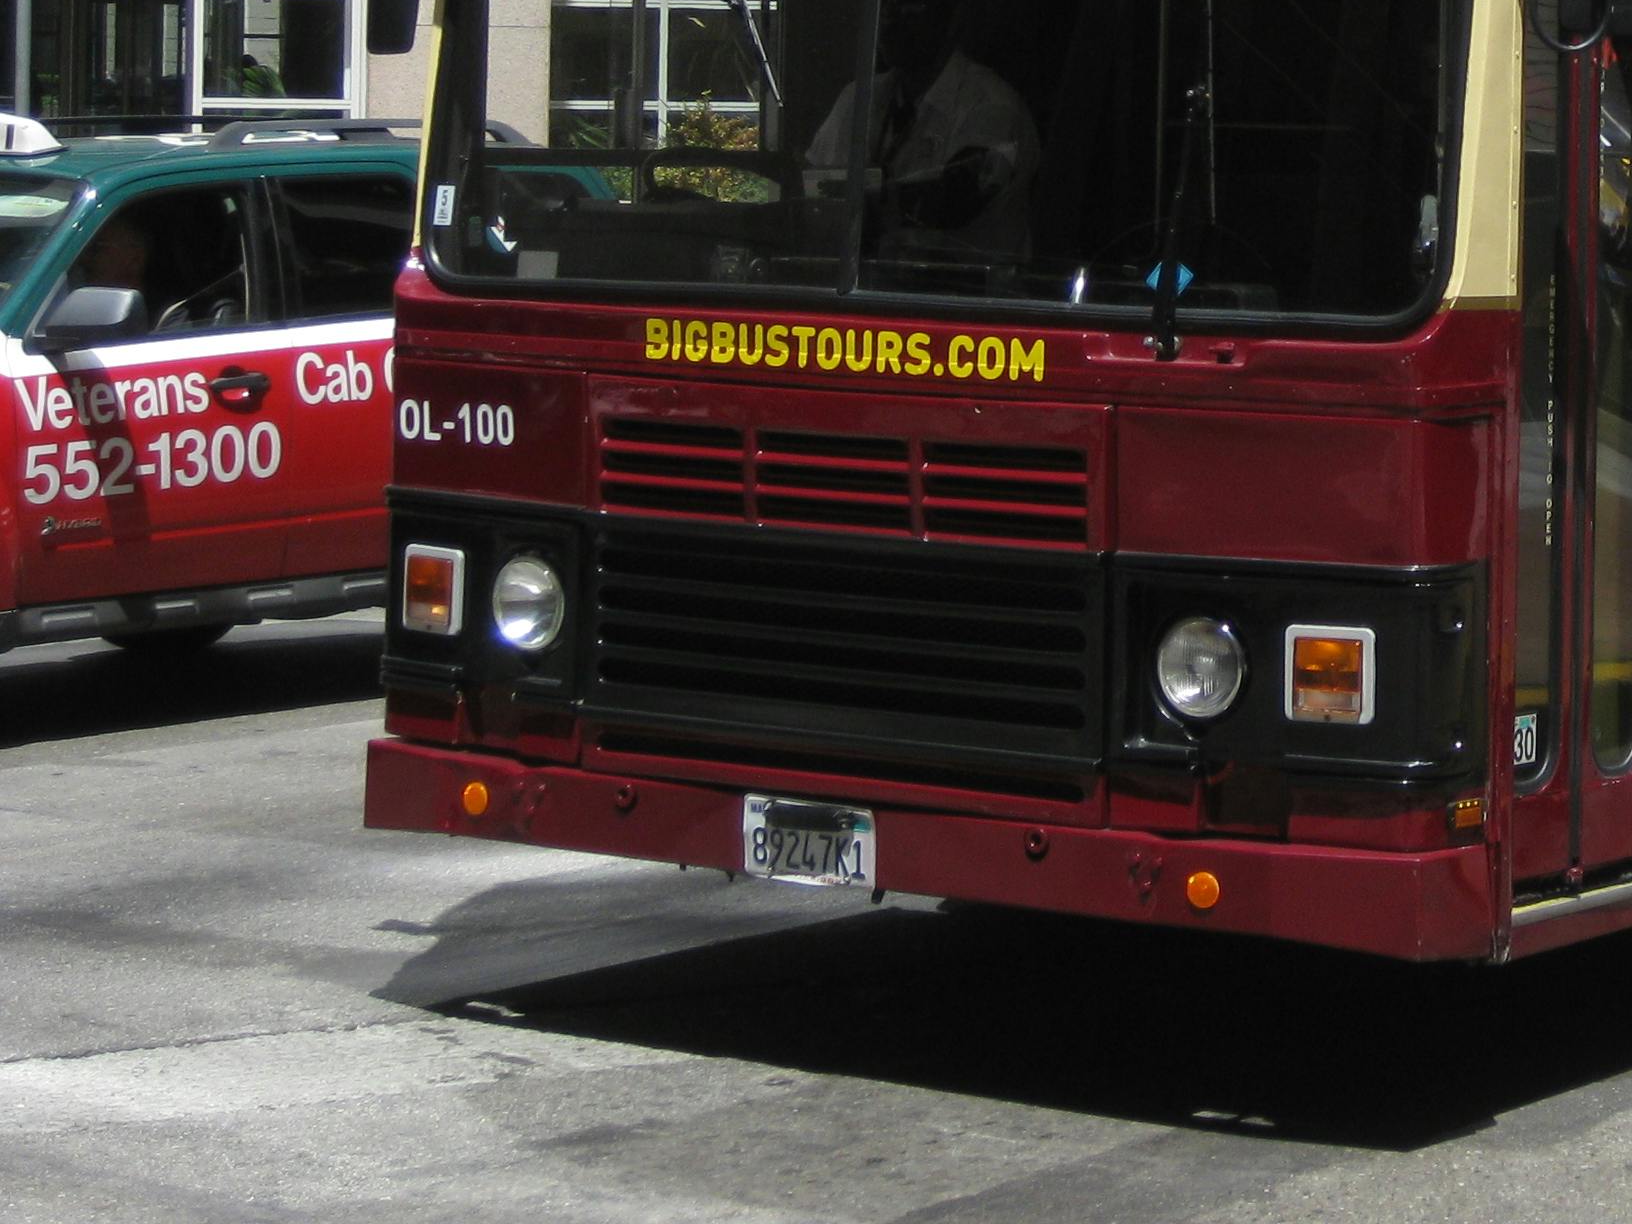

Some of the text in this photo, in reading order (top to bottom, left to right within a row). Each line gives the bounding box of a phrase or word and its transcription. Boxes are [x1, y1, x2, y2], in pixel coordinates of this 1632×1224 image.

[645, 317, 1046, 382] BIGBUSTOURS.COM
[14, 369, 210, 431] Veterans
[295, 350, 374, 405] Cab
[400, 398, 515, 446] OL-100
[24, 421, 282, 504] 552-1300
[1514, 727, 1534, 762] 30
[753, 827, 866, 880] 89247K1
